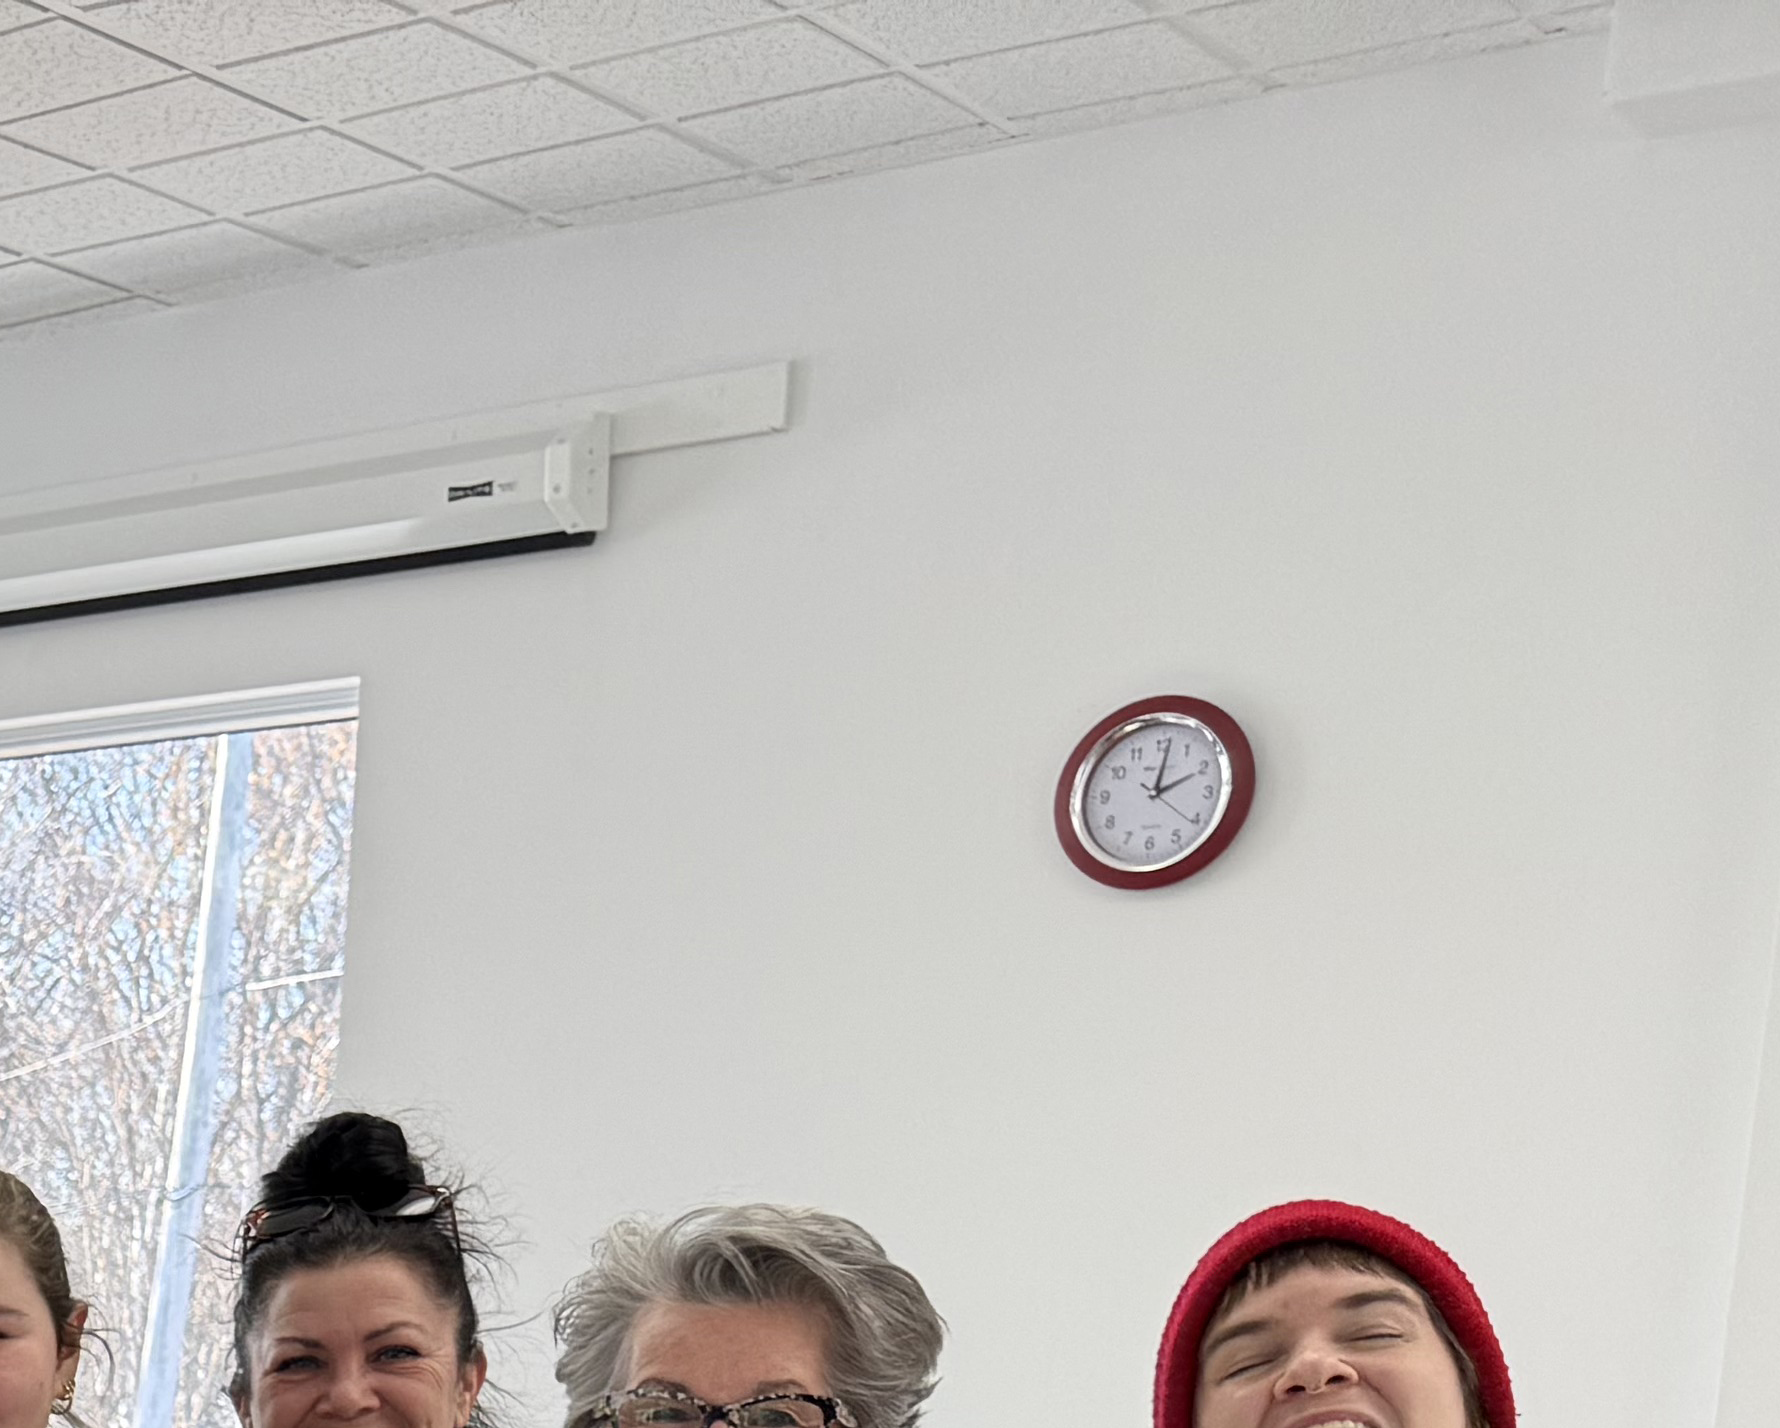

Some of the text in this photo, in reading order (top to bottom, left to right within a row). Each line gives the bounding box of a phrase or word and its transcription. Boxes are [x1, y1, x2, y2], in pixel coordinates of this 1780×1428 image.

[1131, 747, 1142, 760] 11
[1111, 765, 1126, 779] 10
[1198, 760, 1209, 774] 2
[1100, 789, 1110, 804] 9
[1202, 785, 1213, 799] 3
[1105, 815, 1115, 829] 8
[1123, 831, 1133, 845] 7
[1144, 836, 1154, 850] 6
[1171, 829, 1181, 843] 5
